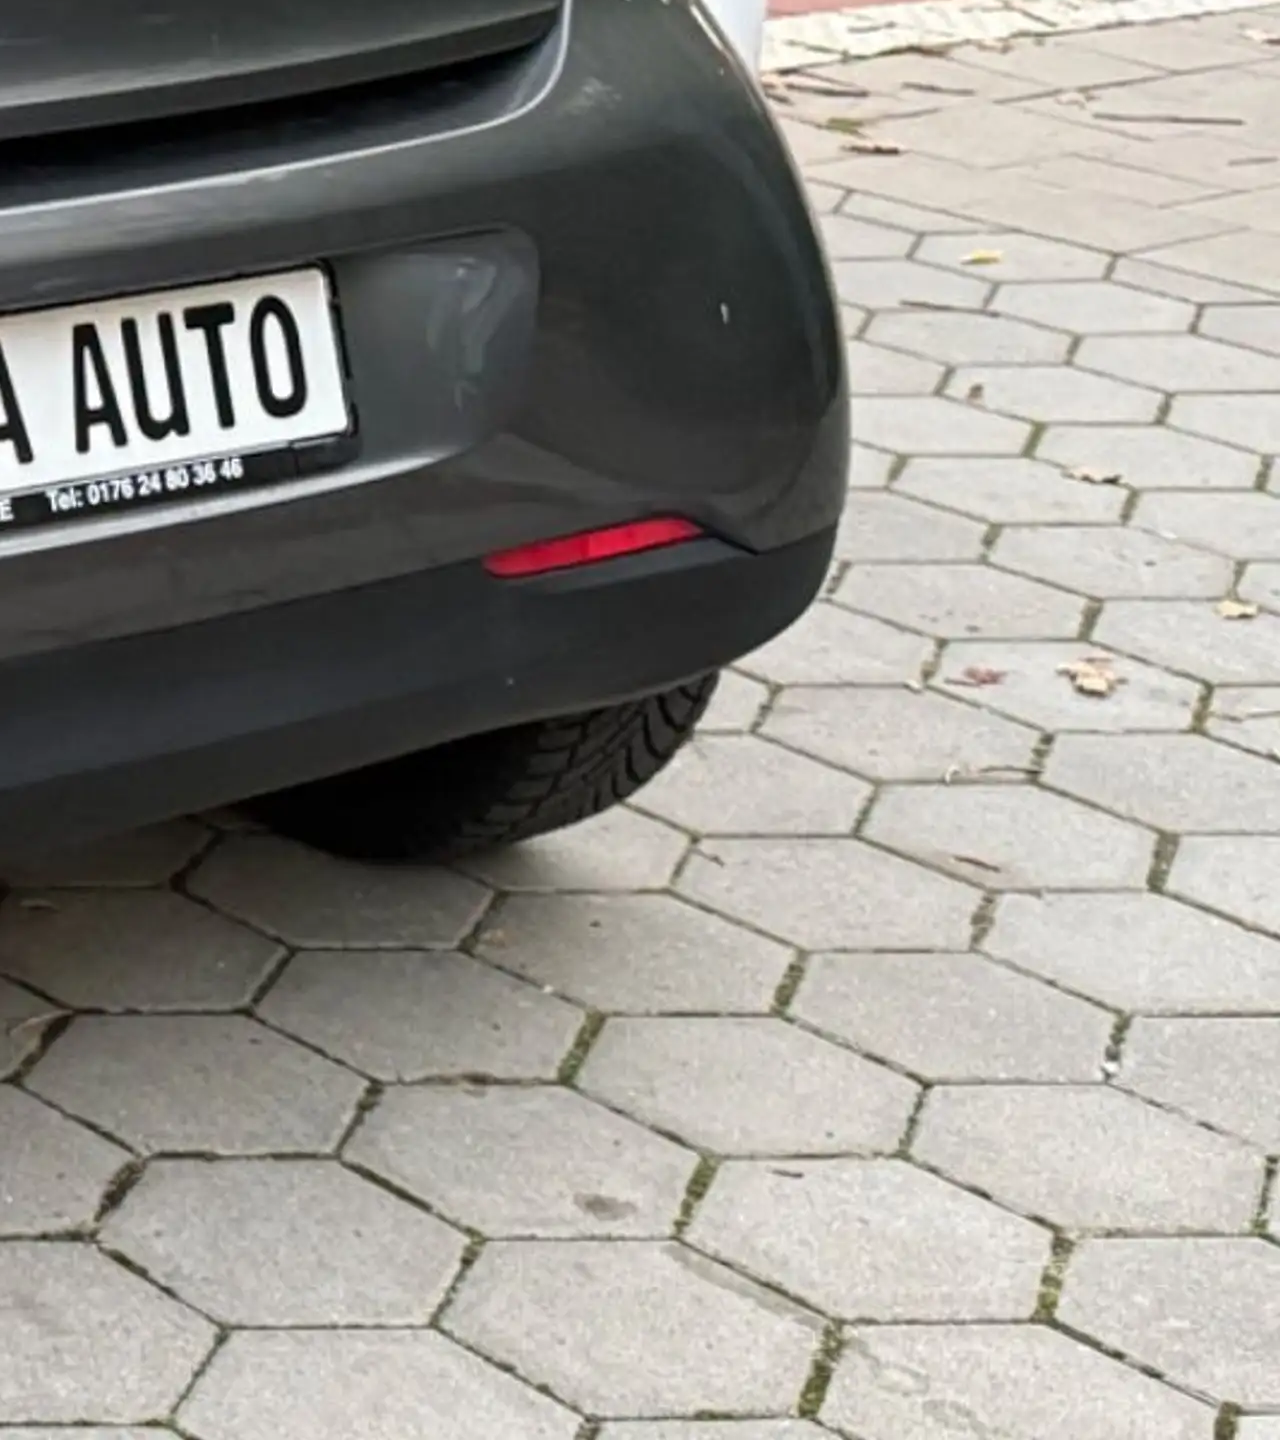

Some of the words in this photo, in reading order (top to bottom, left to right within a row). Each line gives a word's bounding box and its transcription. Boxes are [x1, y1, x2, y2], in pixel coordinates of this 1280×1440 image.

[71, 294, 307, 453] AUTO
[46, 486, 84, 512] Tel:
[87, 479, 134, 506] 0176
[138, 471, 162, 496] 24
[165, 465, 190, 491] 80
[192, 461, 216, 486] 36
[220, 457, 244, 481] 46
